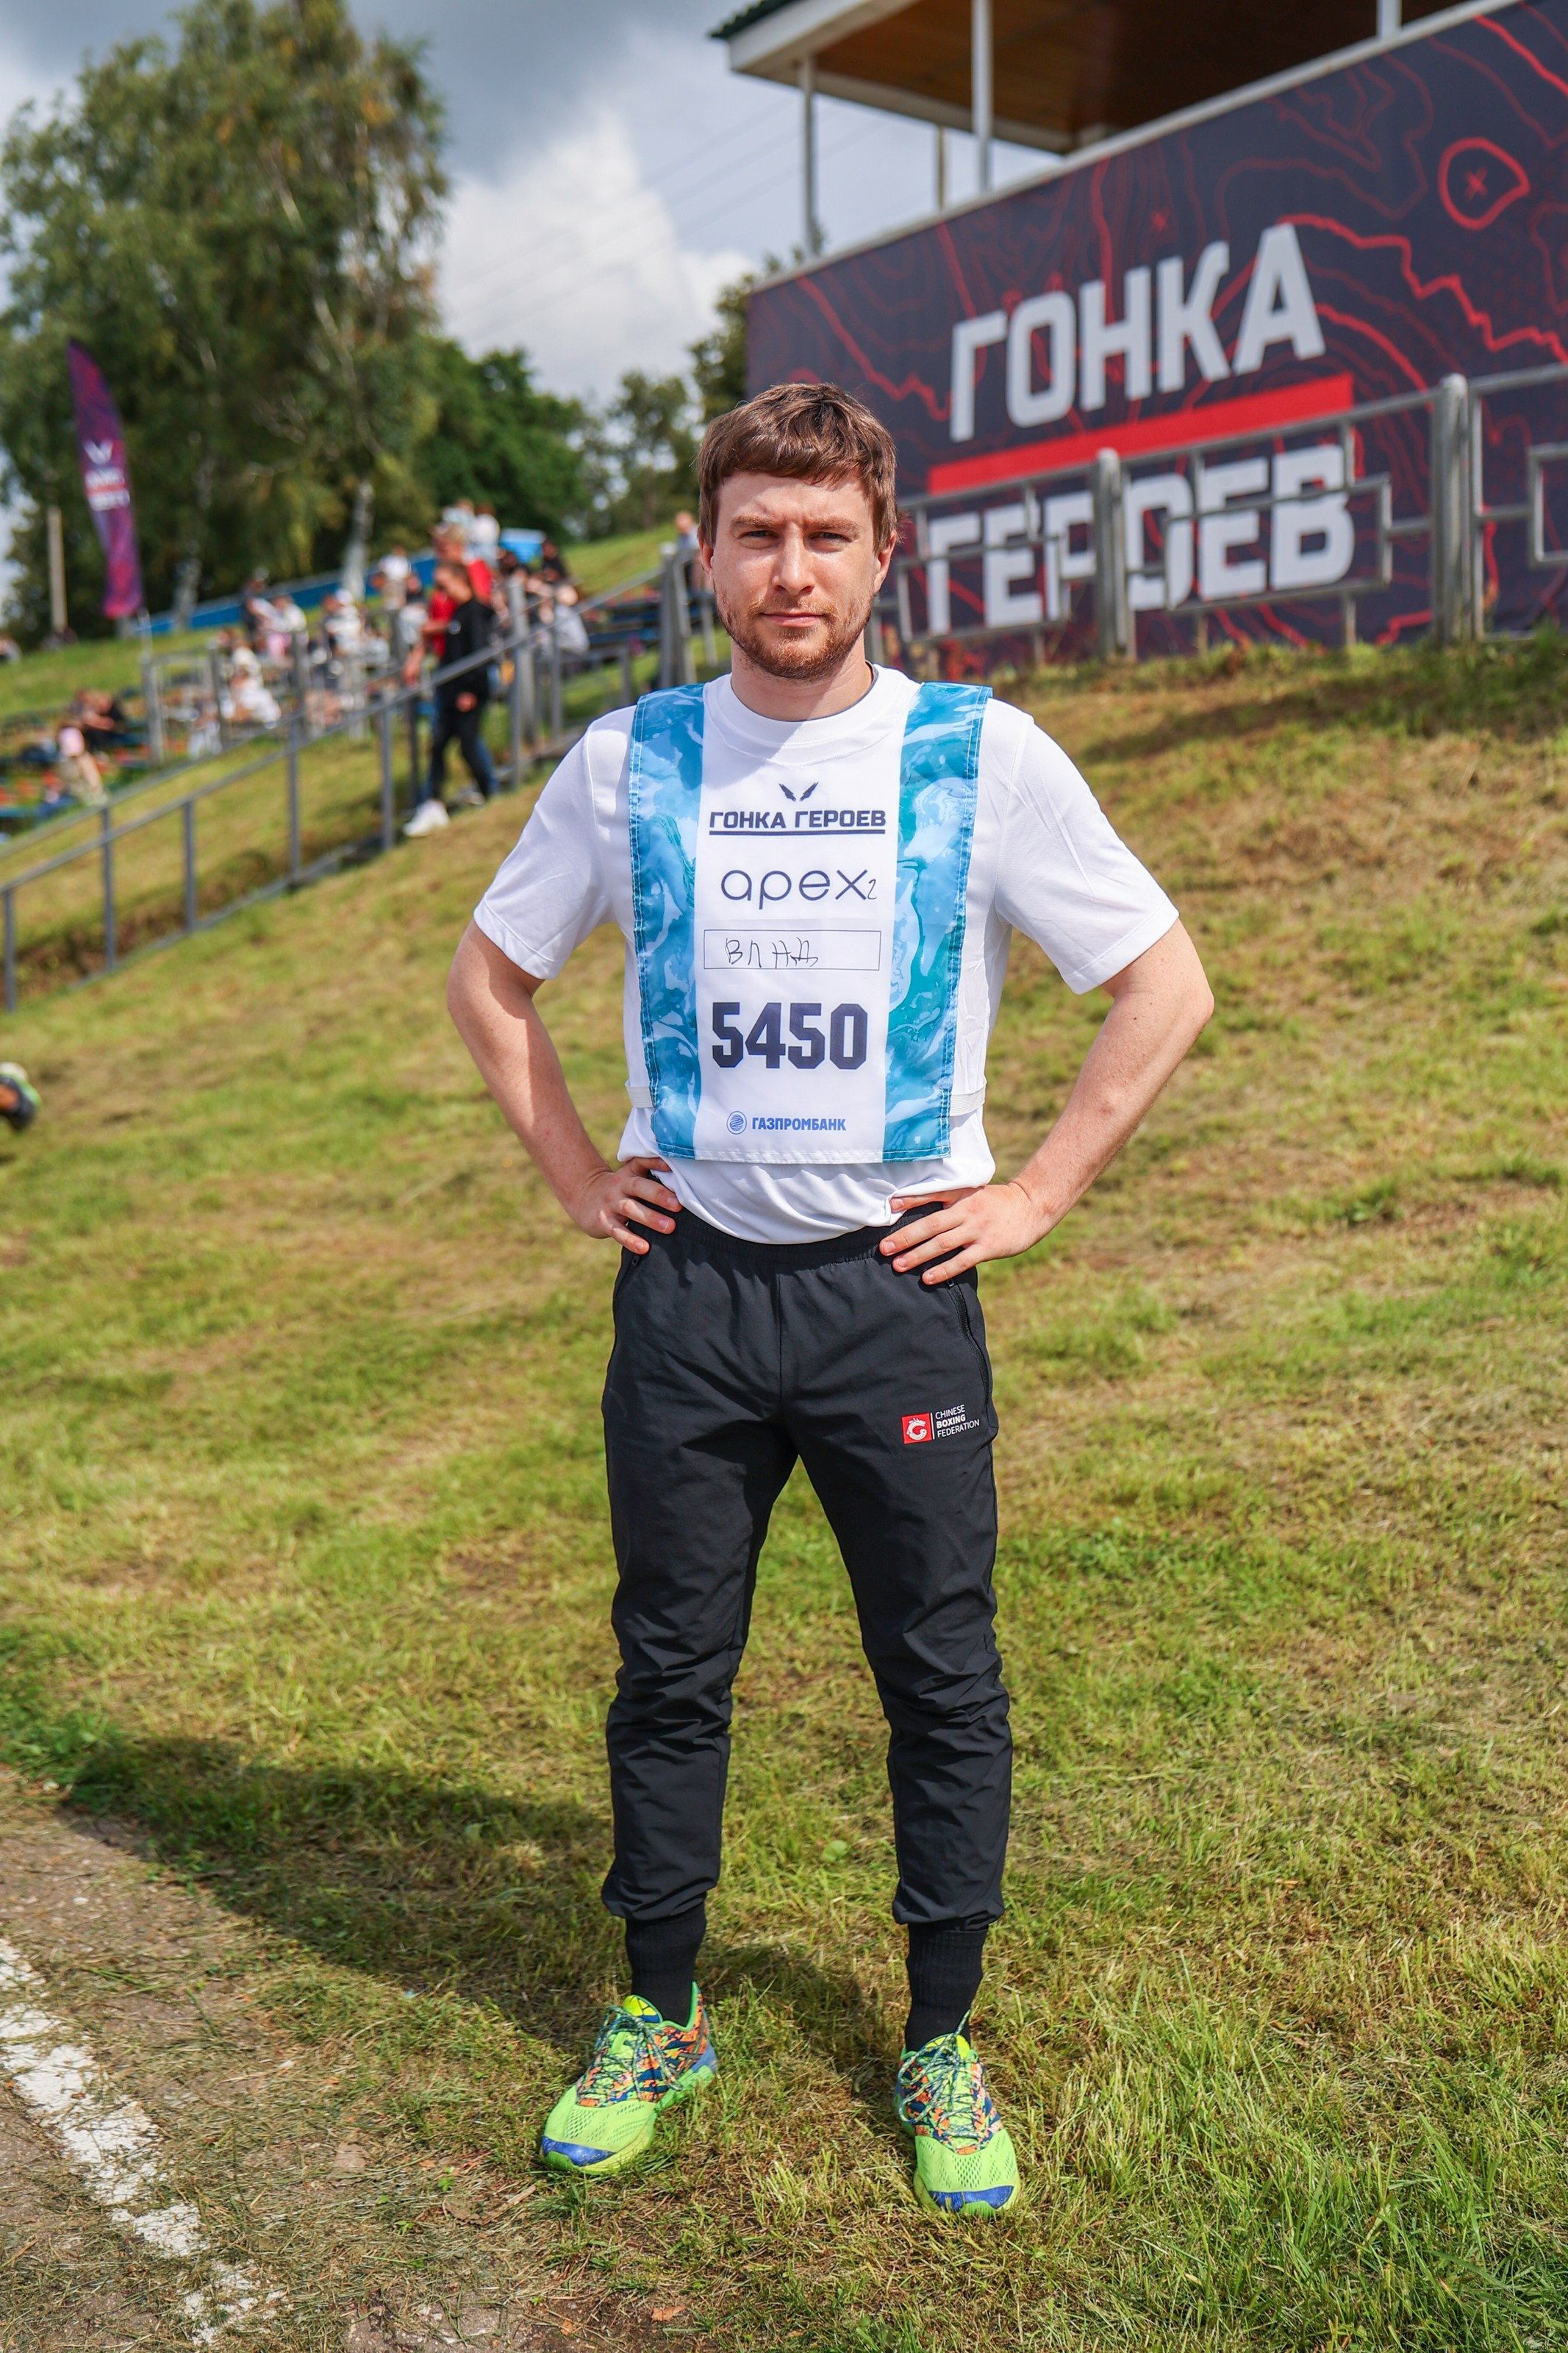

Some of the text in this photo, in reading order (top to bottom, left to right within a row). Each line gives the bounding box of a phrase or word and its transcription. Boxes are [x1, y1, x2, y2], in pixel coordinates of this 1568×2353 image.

[950, 222, 1325, 443] ГОНКА
[926, 443, 1356, 637] ГЕРОЕВ
[709, 810, 887, 829] ГОНКА ГЕРОЕВ
[720, 869, 867, 910] apex
[712, 1001, 868, 1070] 5450
[751, 1117, 847, 1131] ГАЗПРОМБАНК
[935, 1404, 966, 1420] CHINESE
[936, 1413, 967, 1429] BOXING
[937, 1418, 981, 1438] FEDERATION
